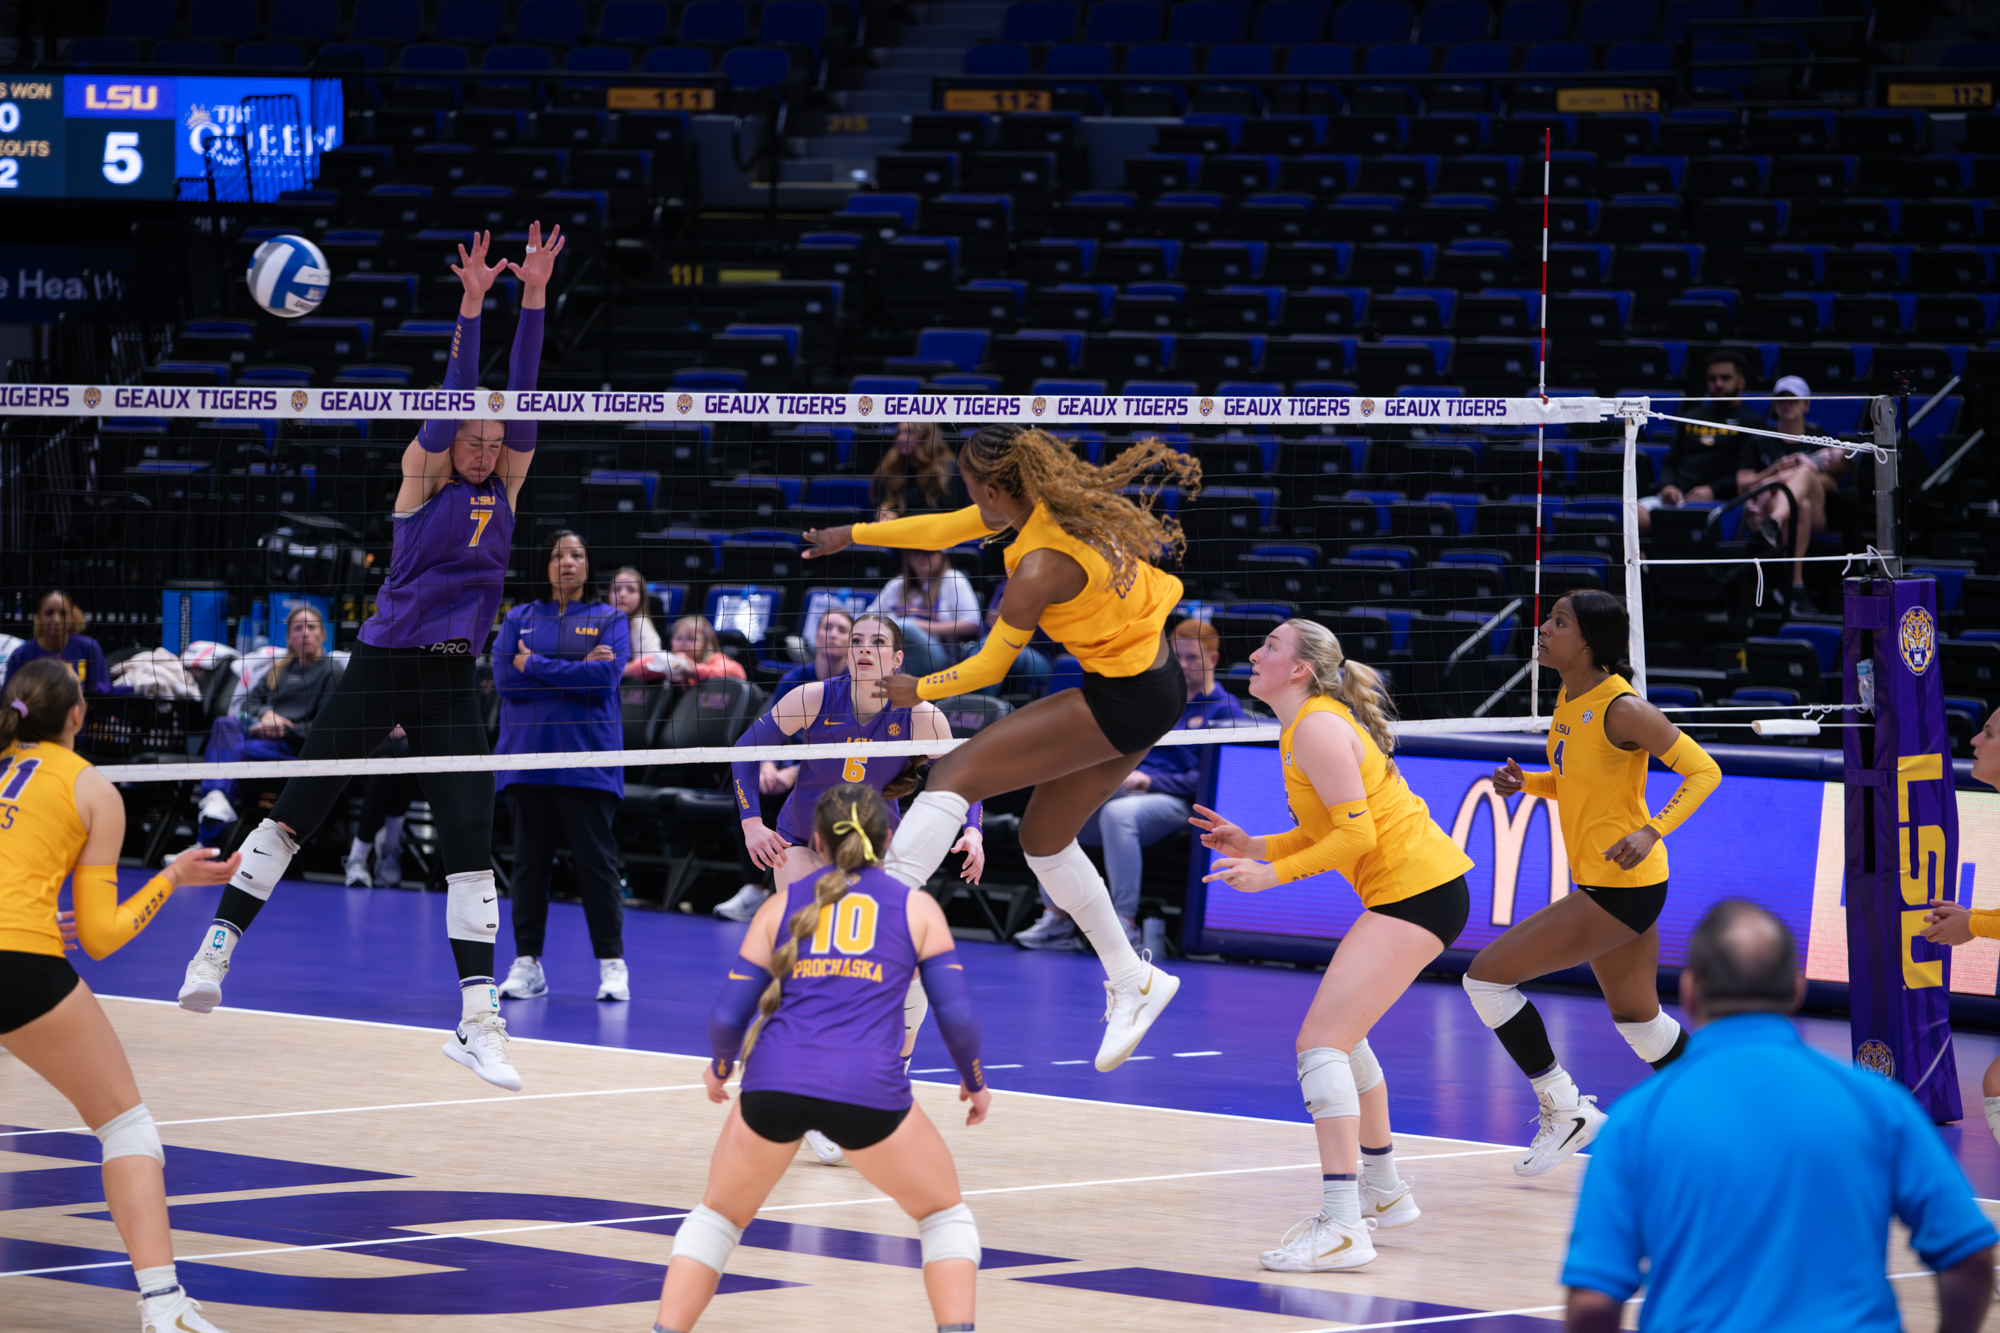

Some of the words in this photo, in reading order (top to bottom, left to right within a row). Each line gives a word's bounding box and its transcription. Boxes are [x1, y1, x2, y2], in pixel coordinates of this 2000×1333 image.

[10, 82, 52, 99] WON
[85, 83, 158, 110] LSU
[653, 92, 701, 106] 111
[1952, 87, 1983, 105] 112
[102, 131, 143, 185] 5
[0, 157, 19, 189] 2
[115, 386, 190, 408] GEAUX
[198, 387, 276, 410] TIGERS
[321, 392, 392, 410] GEAUX
[400, 392, 475, 411] TIGERS
[517, 394, 584, 412] GEAUX
[592, 394, 664, 412] TIGERS
[705, 396, 769, 414] GEAUX
[777, 396, 846, 414] TIGERS
[885, 397, 946, 415] GEAUX
[954, 398, 1020, 415] TIGERS
[1058, 398, 1117, 415] GEAUX
[1124, 398, 1187, 415] TIGERS
[1225, 399, 1281, 415] GEAUX
[1288, 399, 1349, 416] TIGERS
[1385, 400, 1440, 416] GEAUX
[1447, 400, 1506, 416] TIGERS
[470, 495, 496, 506] LSU
[468, 509, 493, 547] 7
[575, 626, 599, 636] LSU
[430, 642, 468, 654] PRO
[887, 722, 901, 737] SEC
[1555, 722, 1571, 736] LSU
[1553, 738, 1565, 778] 4
[842, 757, 868, 783] 6
[1656, 788, 1688, 820] TIGERS
[1897, 753, 1947, 990] LSU
[810, 892, 879, 955] 10
[792, 958, 883, 983] PROCHASKA
